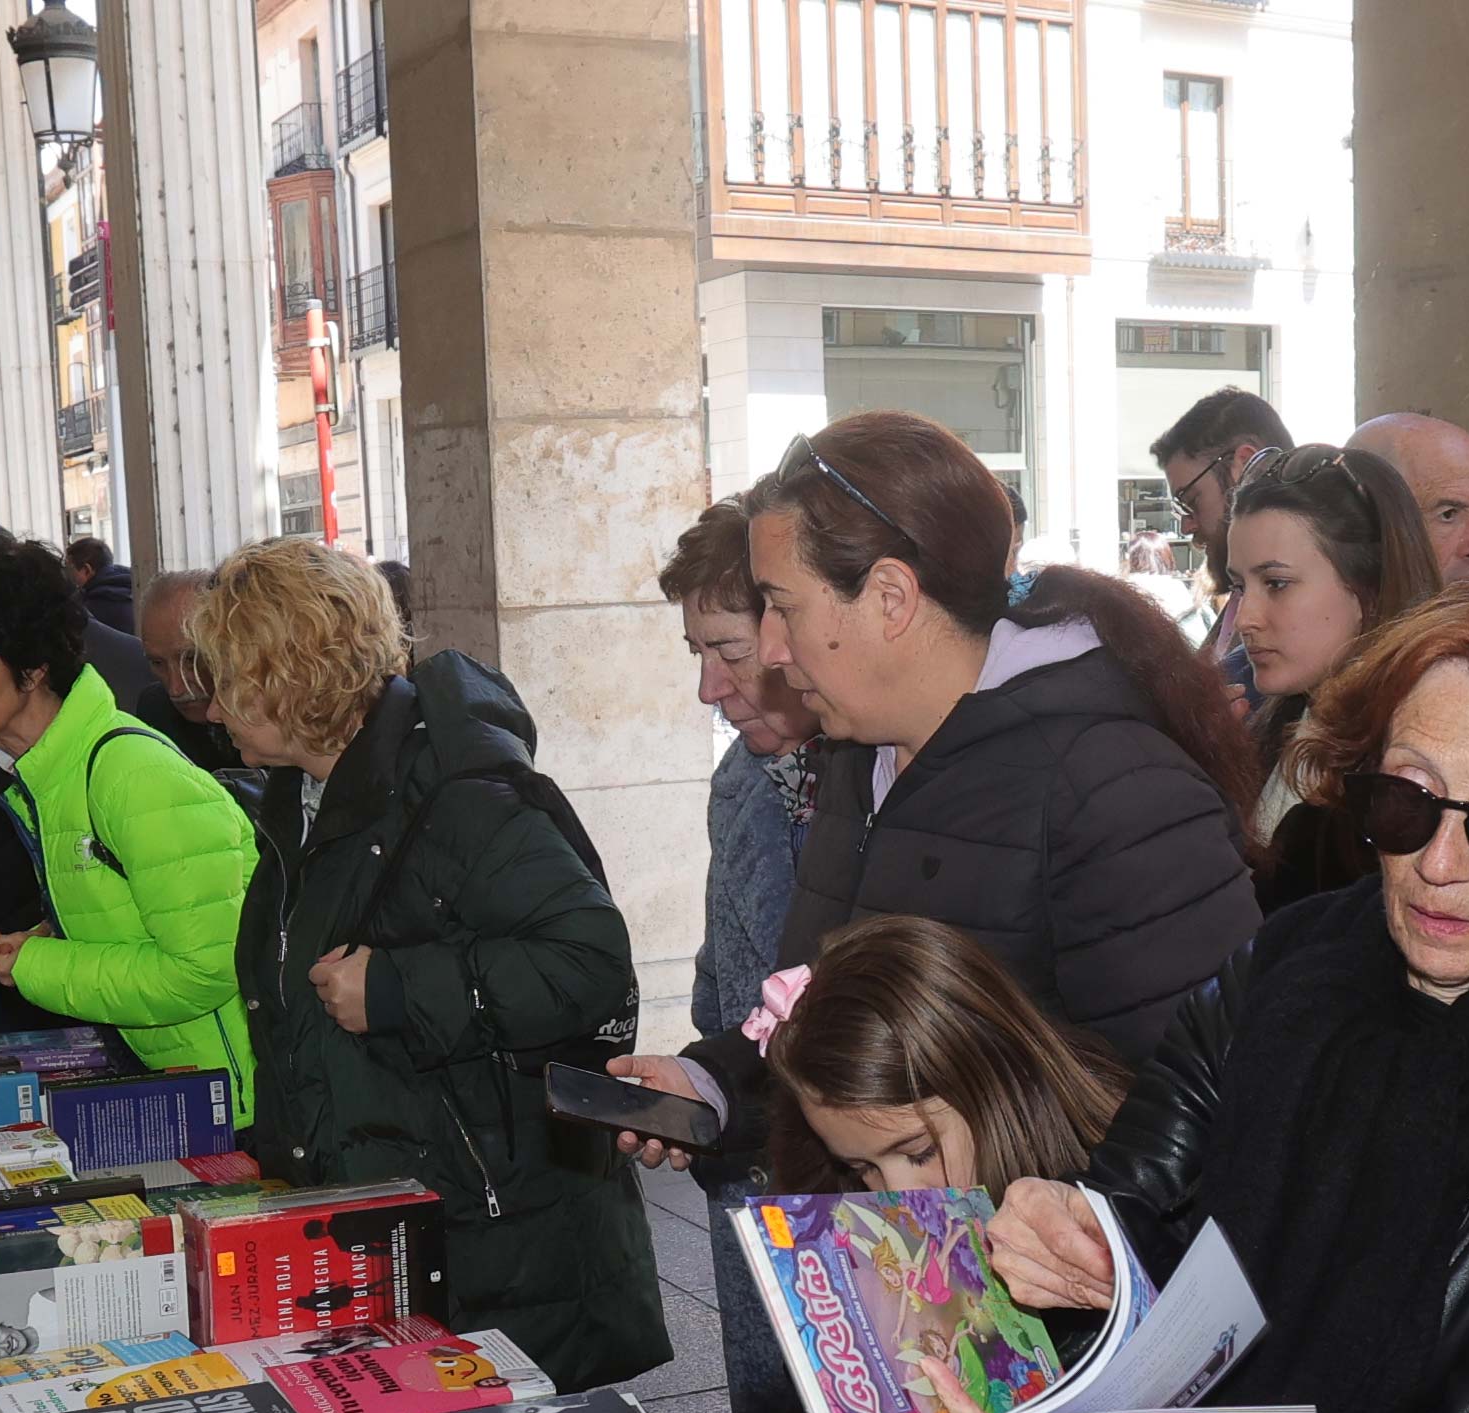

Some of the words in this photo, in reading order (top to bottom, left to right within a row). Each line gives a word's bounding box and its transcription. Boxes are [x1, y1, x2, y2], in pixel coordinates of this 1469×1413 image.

[308, 1360, 355, 1402] cerebro
[336, 1356, 365, 1386] tiene
[353, 1352, 402, 1396] hambre
[882, 1364, 905, 1399] bosque
